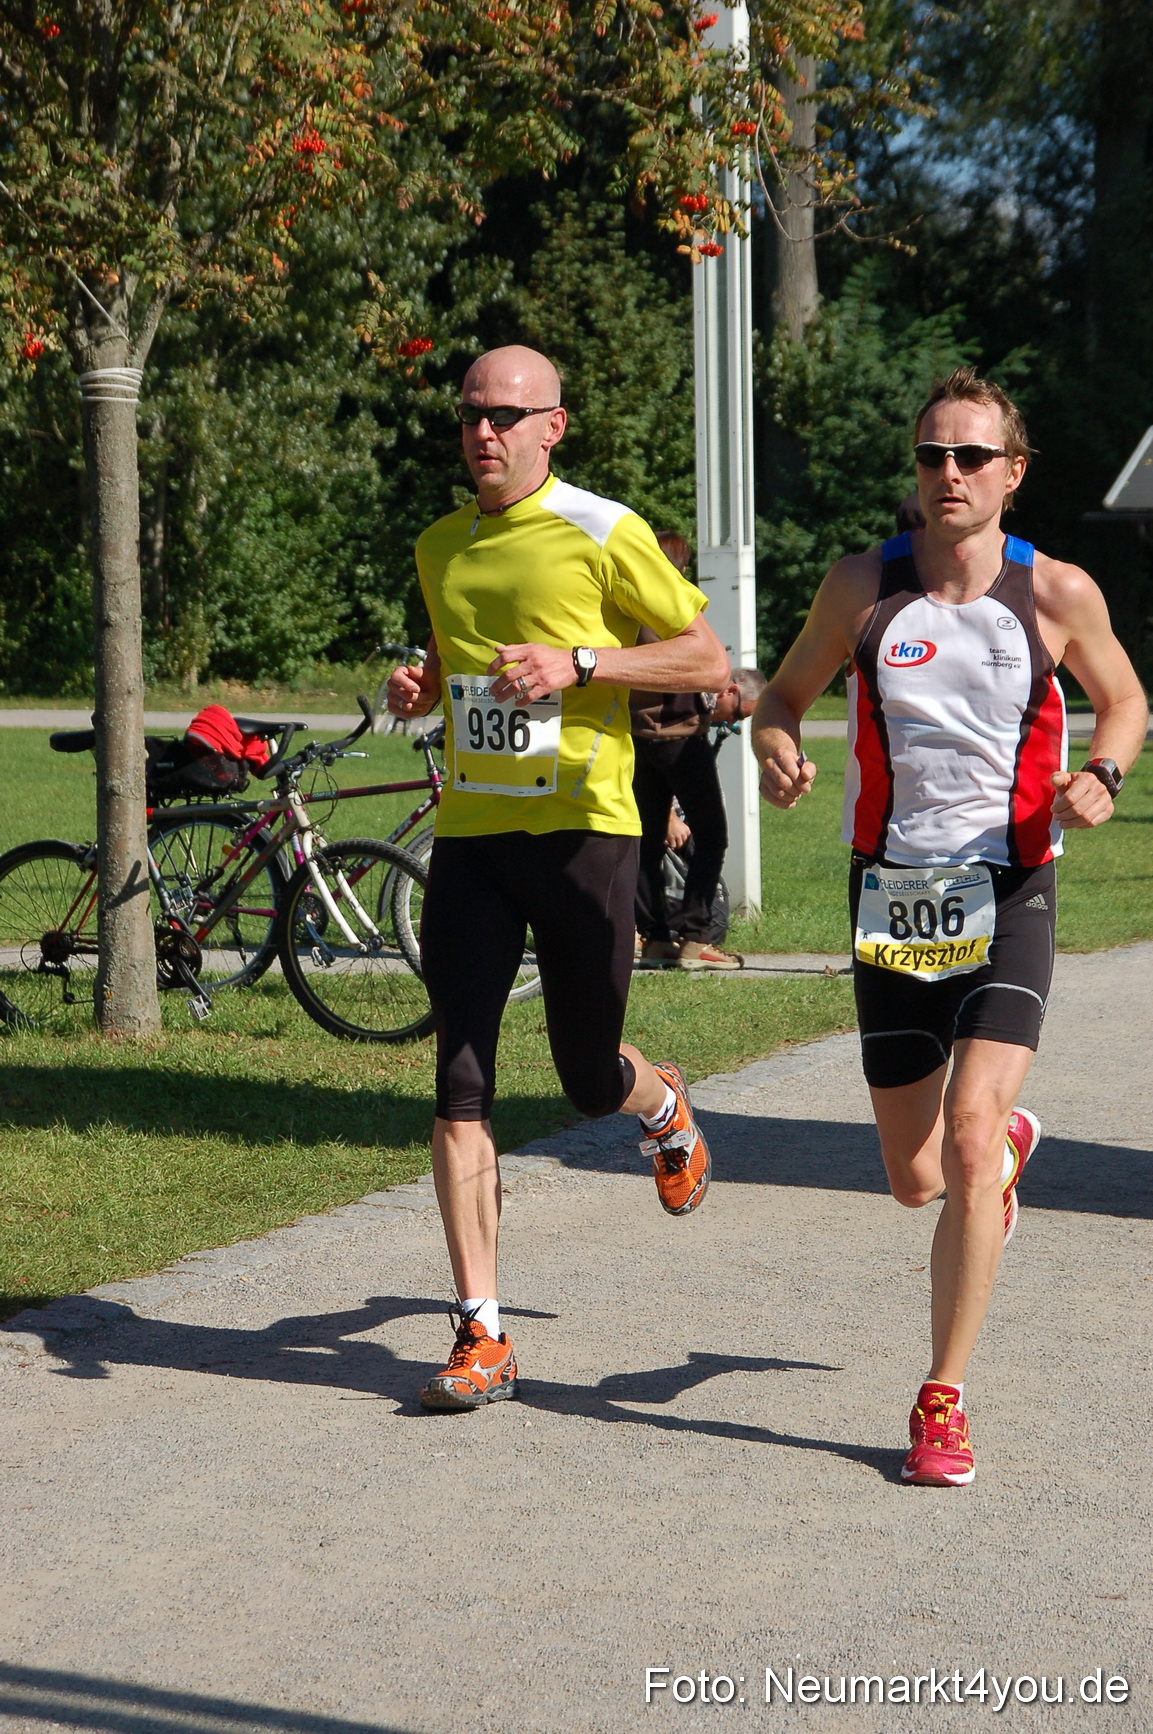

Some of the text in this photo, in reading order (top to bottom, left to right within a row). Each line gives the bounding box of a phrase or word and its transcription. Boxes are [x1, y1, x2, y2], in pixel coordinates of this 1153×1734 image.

[891, 642, 924, 657] tkn
[981, 660, 1013, 669] nürnberg
[993, 654, 1022, 662] klinikum
[468, 707, 531, 753] 936
[1026, 901, 1049, 910] adidas
[888, 896, 966, 940] 806
[874, 940, 977, 971] Krzysztof
